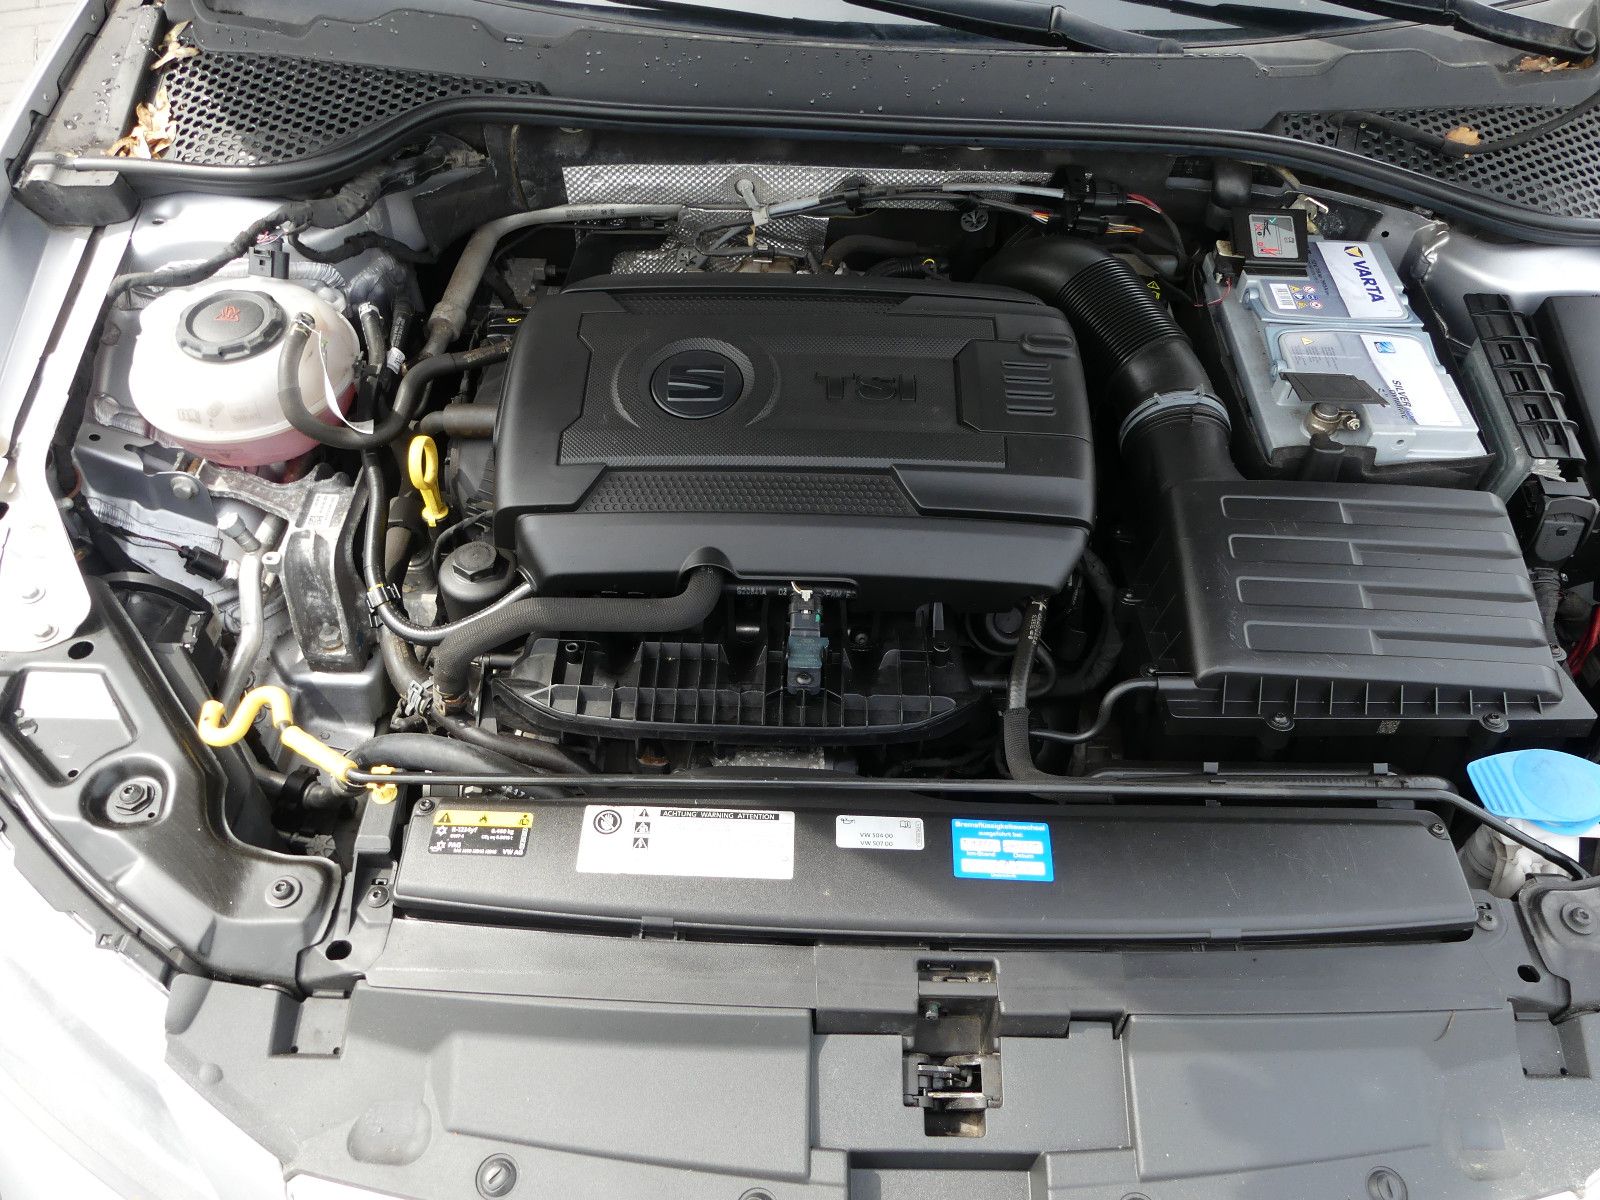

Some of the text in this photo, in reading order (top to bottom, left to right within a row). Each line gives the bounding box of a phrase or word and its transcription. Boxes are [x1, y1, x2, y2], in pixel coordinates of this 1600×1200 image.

[1353, 260, 1385, 303] VARTA
[814, 371, 918, 402] TSI
[1392, 379, 1412, 407] SILVER
[700, 811, 734, 819] WARNING
[737, 812, 775, 820] ATTENTION
